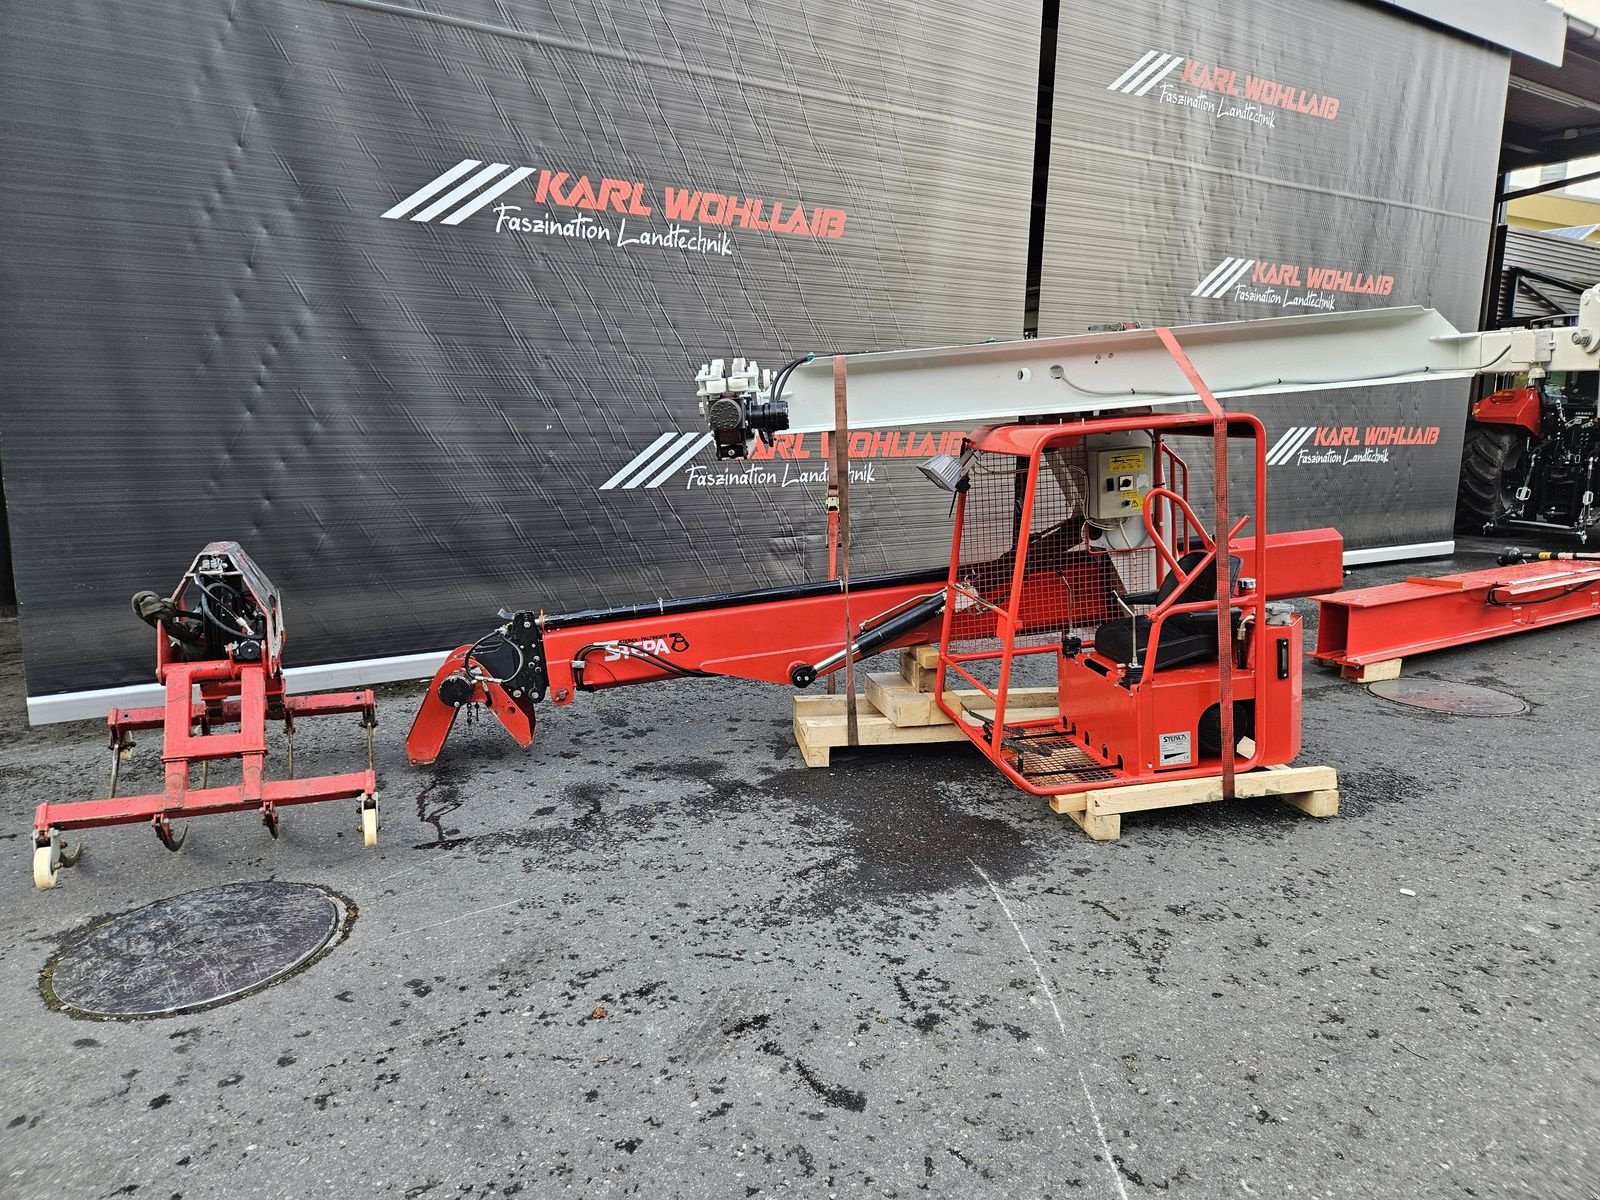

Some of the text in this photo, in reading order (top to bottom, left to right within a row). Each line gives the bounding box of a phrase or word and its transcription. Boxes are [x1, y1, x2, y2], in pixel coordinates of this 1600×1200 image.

[1181, 58, 1239, 97] KARL
[1159, 82, 1275, 128] Faszination Landtechnik
[535, 169, 652, 217] KARL
[493, 203, 732, 256] Faszination Landtechnik
[1252, 260, 1301, 287] KARL
[1234, 282, 1336, 310] Faszination Landtechnik
[746, 432, 810, 459] ARL
[1313, 426, 1360, 446] KARL
[1297, 448, 1389, 466] Faszination Landtechnik
[685, 463, 776, 490] Faszination
